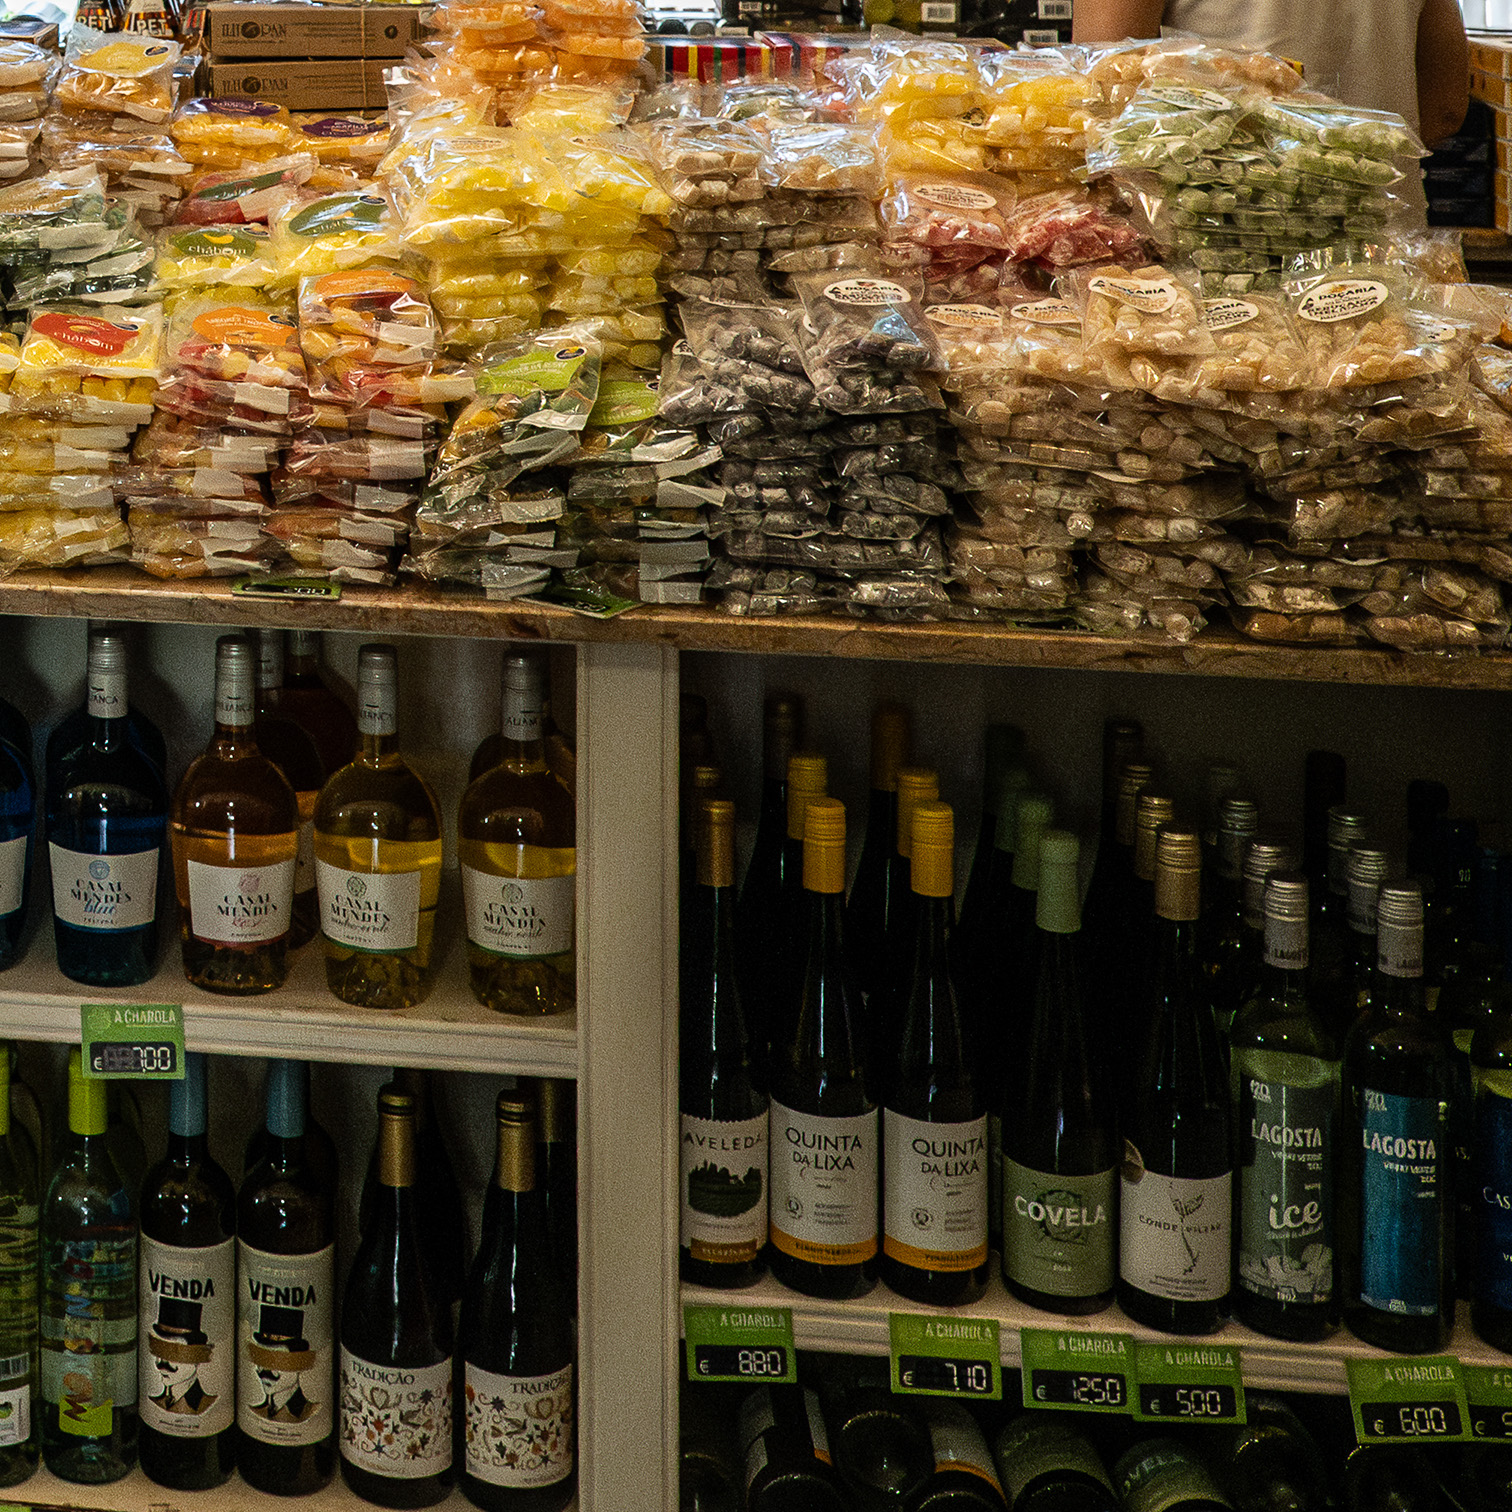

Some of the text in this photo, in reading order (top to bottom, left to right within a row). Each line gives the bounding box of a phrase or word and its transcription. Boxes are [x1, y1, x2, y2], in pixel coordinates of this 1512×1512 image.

[136, 19, 170, 37] PET
[77, 878, 123, 893] CASAL
[70, 889, 133, 904] MENDES
[335, 893, 384, 912] CASAL
[217, 902, 279, 919] MENDES
[330, 902, 391, 925] MENDES
[487, 902, 538, 917] CASAL
[483, 911, 547, 929] MENDES
[114, 1008, 176, 1023] A CHAROLA
[786, 1127, 863, 1152] QUINTA
[1251, 1118, 1323, 1149] LAGOSTA
[912, 1137, 986, 1158] QUINTA
[1362, 1128, 1437, 1161] LAGOSTA
[793, 1151, 856, 1171] DA LIXA
[921, 1159, 981, 1178] DA LIXA
[1014, 1195, 1108, 1228] COVELA
[1269, 1194, 1323, 1230] ice
[1139, 1215, 1178, 1232] CONDE
[149, 1269, 216, 1299] VENDA
[249, 1279, 317, 1307] VENDA
[720, 1312, 786, 1329] A CHAROLA
[925, 1322, 993, 1340] A CHAROLA
[1057, 1337, 1126, 1355] A CHAROLA
[1165, 1350, 1234, 1367] A CHAROLA
[352, 1360, 416, 1387] TRADIÇÃO
[1385, 1365, 1455, 1382] A CHAROLA
